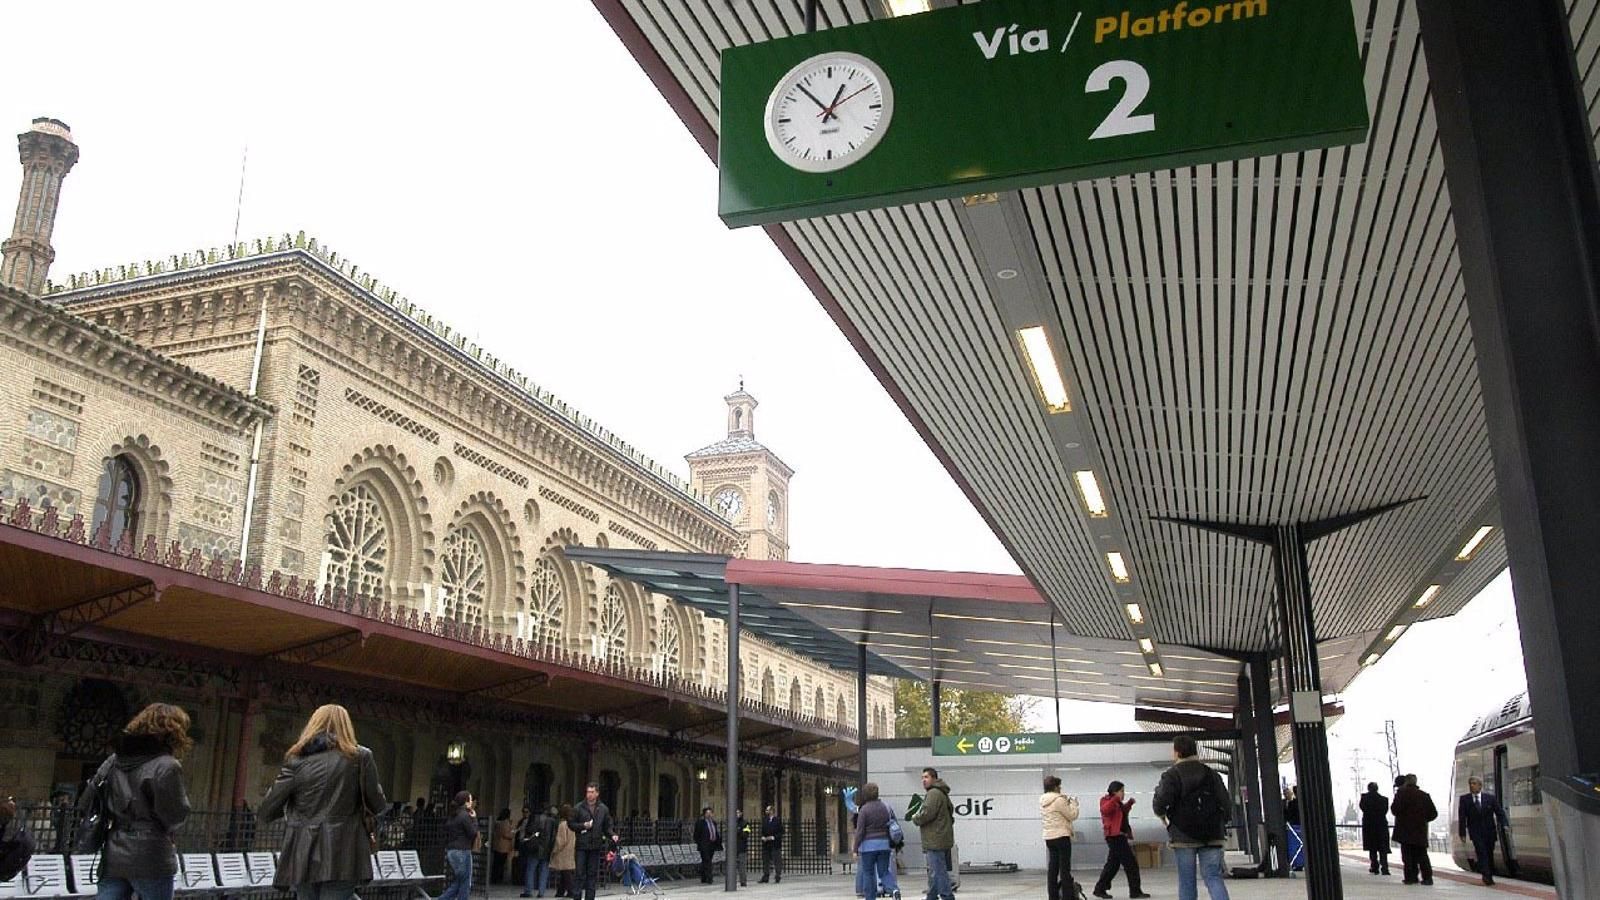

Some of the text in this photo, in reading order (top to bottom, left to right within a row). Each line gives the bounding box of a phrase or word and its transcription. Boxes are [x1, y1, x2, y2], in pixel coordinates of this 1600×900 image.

[972, 23, 1049, 60] Vía
[1094, 0, 1268, 44] Platform
[1085, 59, 1156, 140] 2
[955, 798, 994, 816] dif
